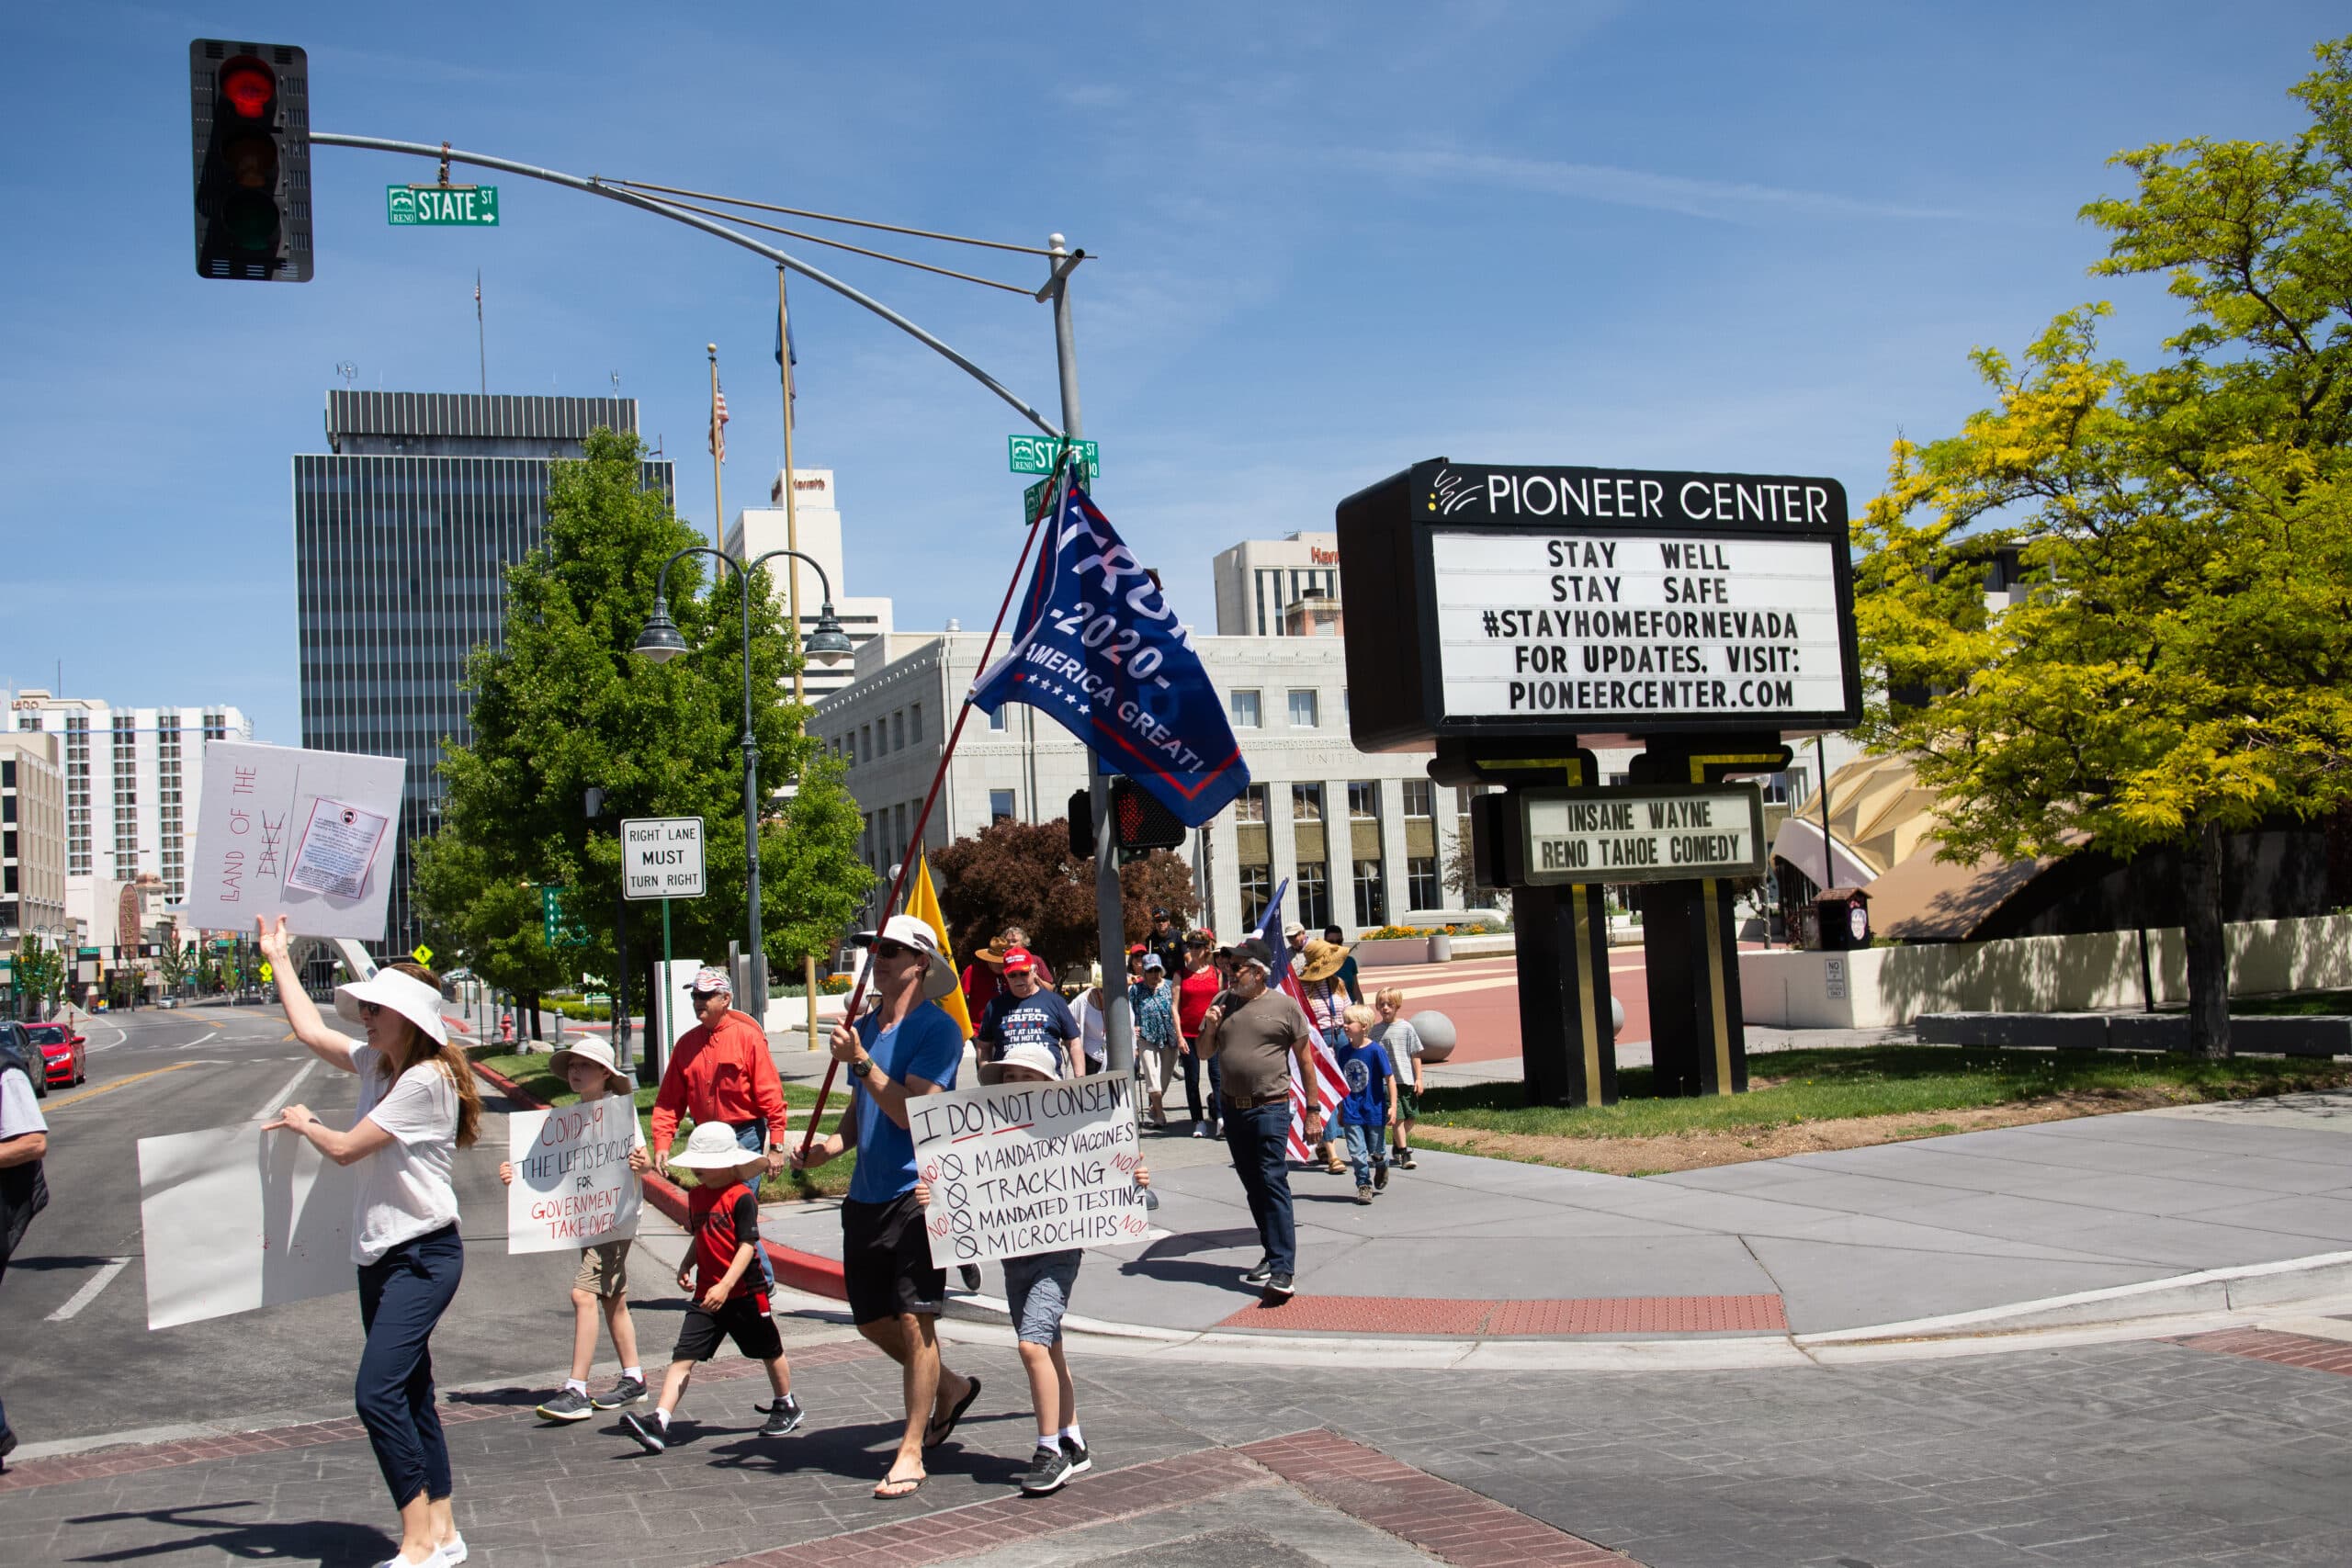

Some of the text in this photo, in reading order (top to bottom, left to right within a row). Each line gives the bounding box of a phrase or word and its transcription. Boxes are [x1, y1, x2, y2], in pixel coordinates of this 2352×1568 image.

[393, 213, 414, 221] RENO
[418, 190, 493, 220] STATE ST
[1014, 461, 1034, 470] RENO
[1035, 441, 1084, 469] STE
[1086, 443, 1096, 457] ST
[1487, 474, 1829, 525] PIONEER CENTER
[1547, 540, 1730, 570] STAY WELL
[1551, 574, 1729, 604] STAY SAFE
[1482, 610, 1799, 639] #STAYHOMEFORNEVADA
[1514, 645, 1568, 674] FOR
[1725, 645, 1801, 674] VISIT:
[1023, 642, 1205, 773] AMERICA GREAT!
[1509, 680, 1793, 710] PIONEERCENTER.COM
[1567, 801, 1713, 832] INSANE WAYNE
[220, 765, 257, 902] LAND OF THE
[629, 828, 696, 842] RIGHT LANE
[642, 850, 684, 865] MUST
[1542, 834, 1740, 869] RENO TAHOE COMEDY
[630, 873, 698, 887] TURN RIGHT
[1828, 962, 1839, 970] NO
[1001, 1013, 1049, 1023] PERFECT
[540, 1105, 604, 1146] COVID-19
[913, 1077, 1131, 1145] I DO NOT CONSENT
[514, 1153, 555, 1179] THE
[596, 1134, 635, 1169] EXCUSE
[975, 1122, 1135, 1176] MANDATORY VACCINES
[577, 1175, 594, 1192] FOR
[976, 1161, 1106, 1204] TRACKING
[531, 1187, 622, 1220] GOVERNMENT
[978, 1185, 1145, 1231] MANDATED TESTING
[546, 1212, 619, 1239] TAKE OVER
[987, 1214, 1118, 1256] MICROCHIPS
